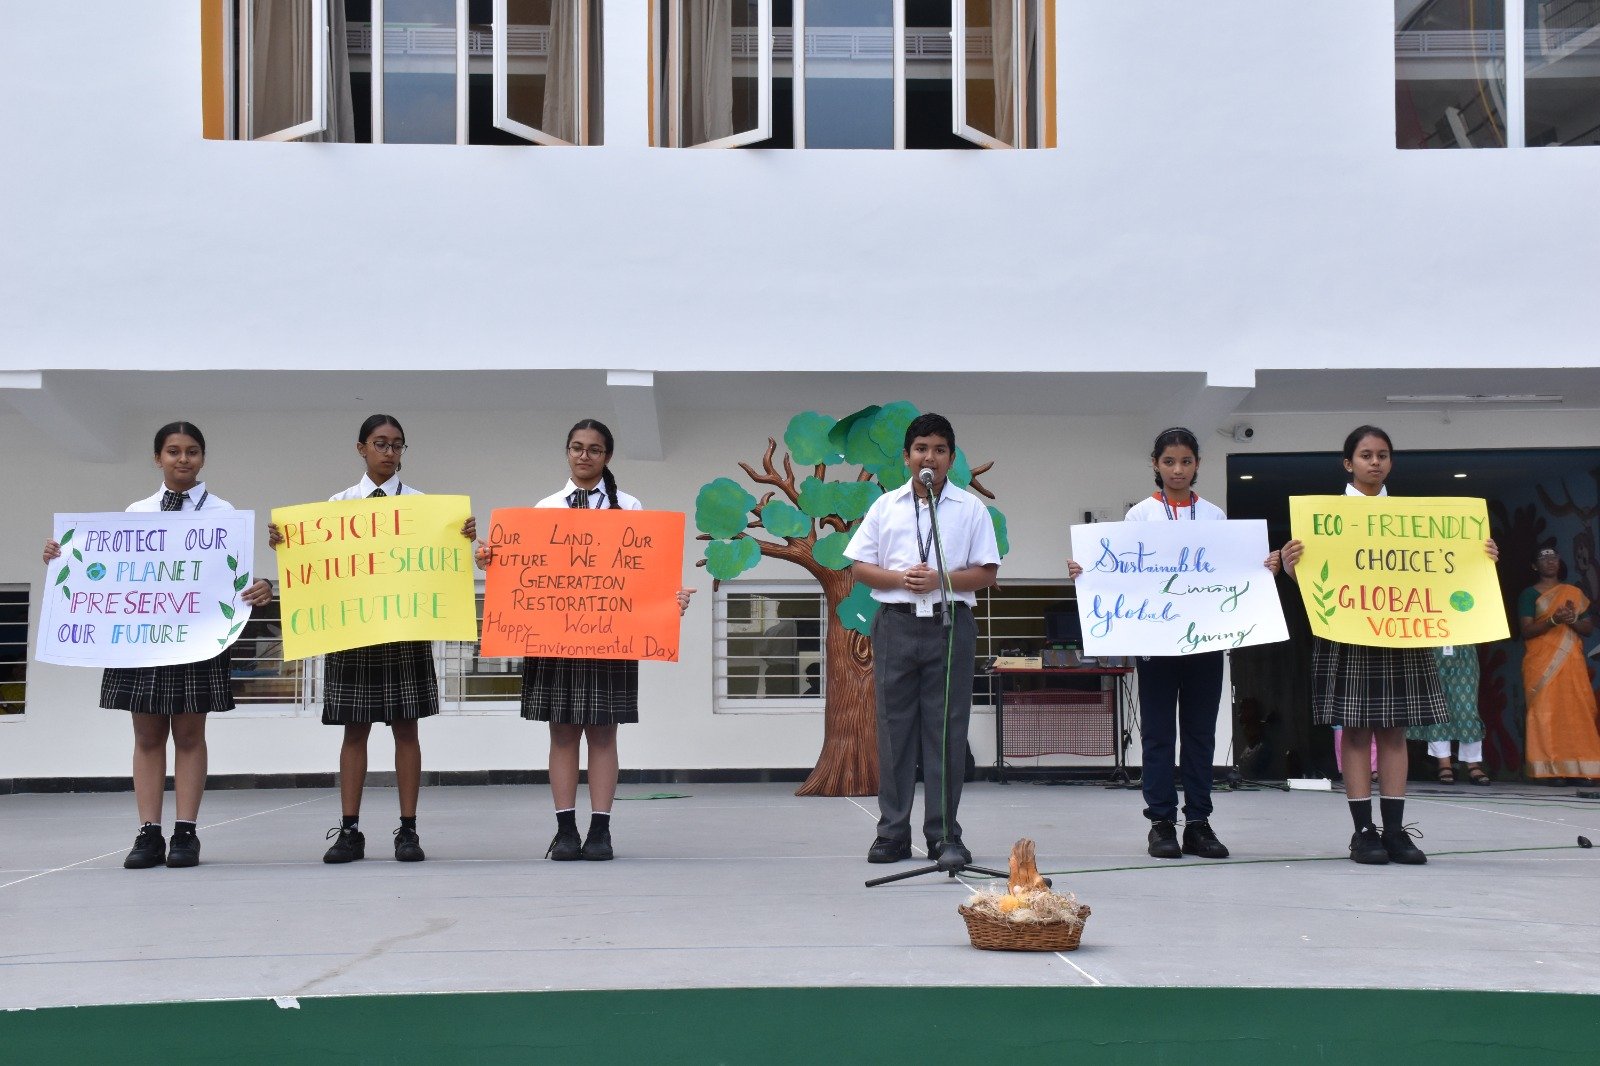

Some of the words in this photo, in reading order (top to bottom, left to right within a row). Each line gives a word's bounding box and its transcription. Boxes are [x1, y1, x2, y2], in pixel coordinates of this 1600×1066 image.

[84, 529, 167, 552] PROTECT
[185, 528, 228, 550] OUR
[283, 508, 416, 548] RESTORE
[1312, 513, 1343, 536] ECO
[1367, 513, 1485, 541] FRIENDLY
[285, 551, 389, 589] NATURE
[390, 546, 465, 573] SECURE
[1086, 537, 1216, 573] Sustainable
[1355, 548, 1456, 574] CHOICE'S
[116, 560, 203, 582] PLANET
[70, 590, 201, 614] PRESERVE
[1159, 573, 1249, 612] Living
[1338, 584, 1443, 613] GLOBAL
[291, 604, 332, 636] OUR
[340, 592, 447, 627] FUTURE
[486, 611, 533, 643] Happy
[565, 614, 613, 634] World
[1086, 593, 1180, 638] Global
[1366, 616, 1451, 638] VOICES
[58, 623, 96, 644] OUR
[111, 624, 189, 644] FUTURE
[524, 634, 634, 655] Environmental
[641, 635, 677, 661] Day
[1177, 621, 1257, 654] Giving
